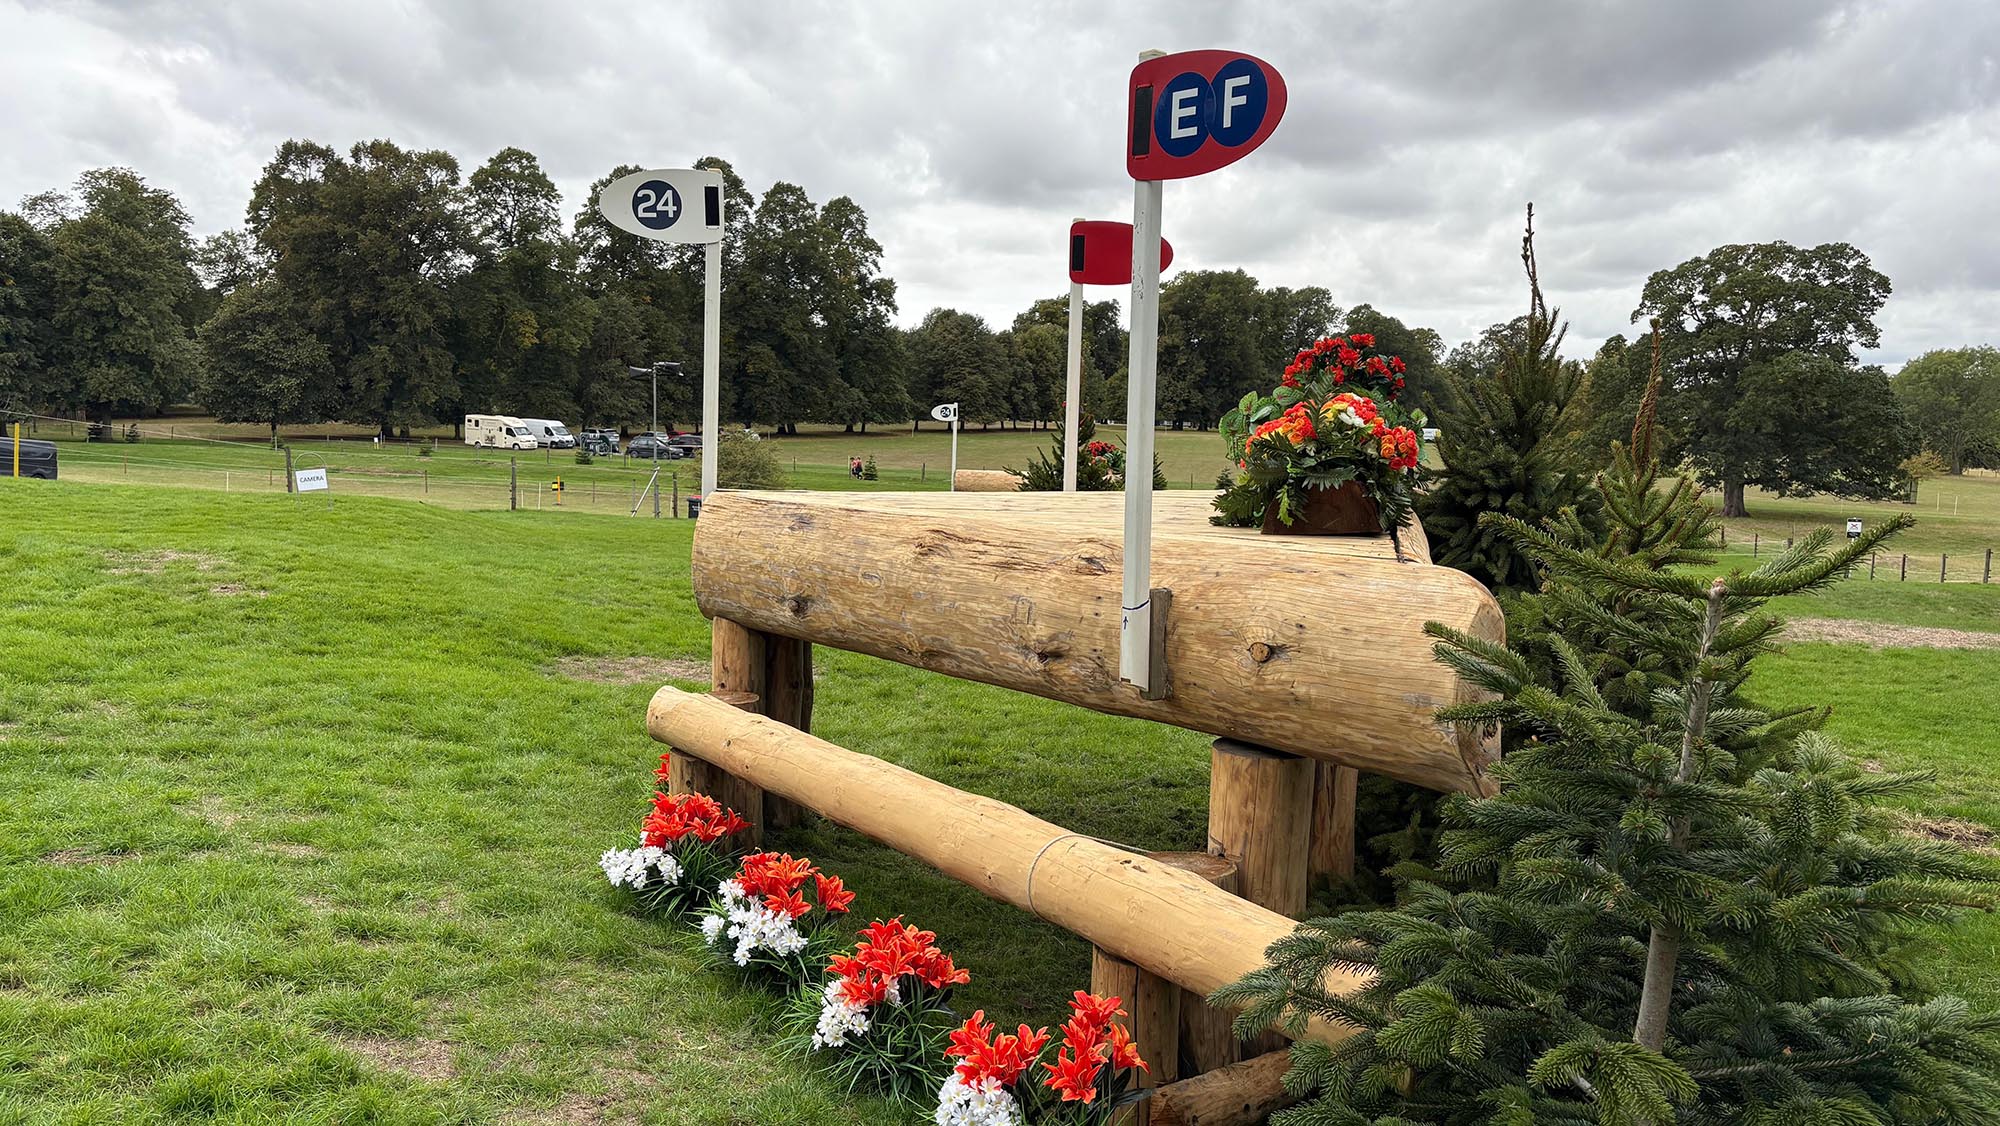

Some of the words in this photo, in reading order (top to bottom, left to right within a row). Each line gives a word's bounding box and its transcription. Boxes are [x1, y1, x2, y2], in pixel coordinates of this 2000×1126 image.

[1170, 87, 1199, 139] E
[1222, 74, 1251, 129] F
[637, 189, 677, 218] 24
[941, 408, 950, 417] 24
[299, 475, 324, 483] CAMERA
